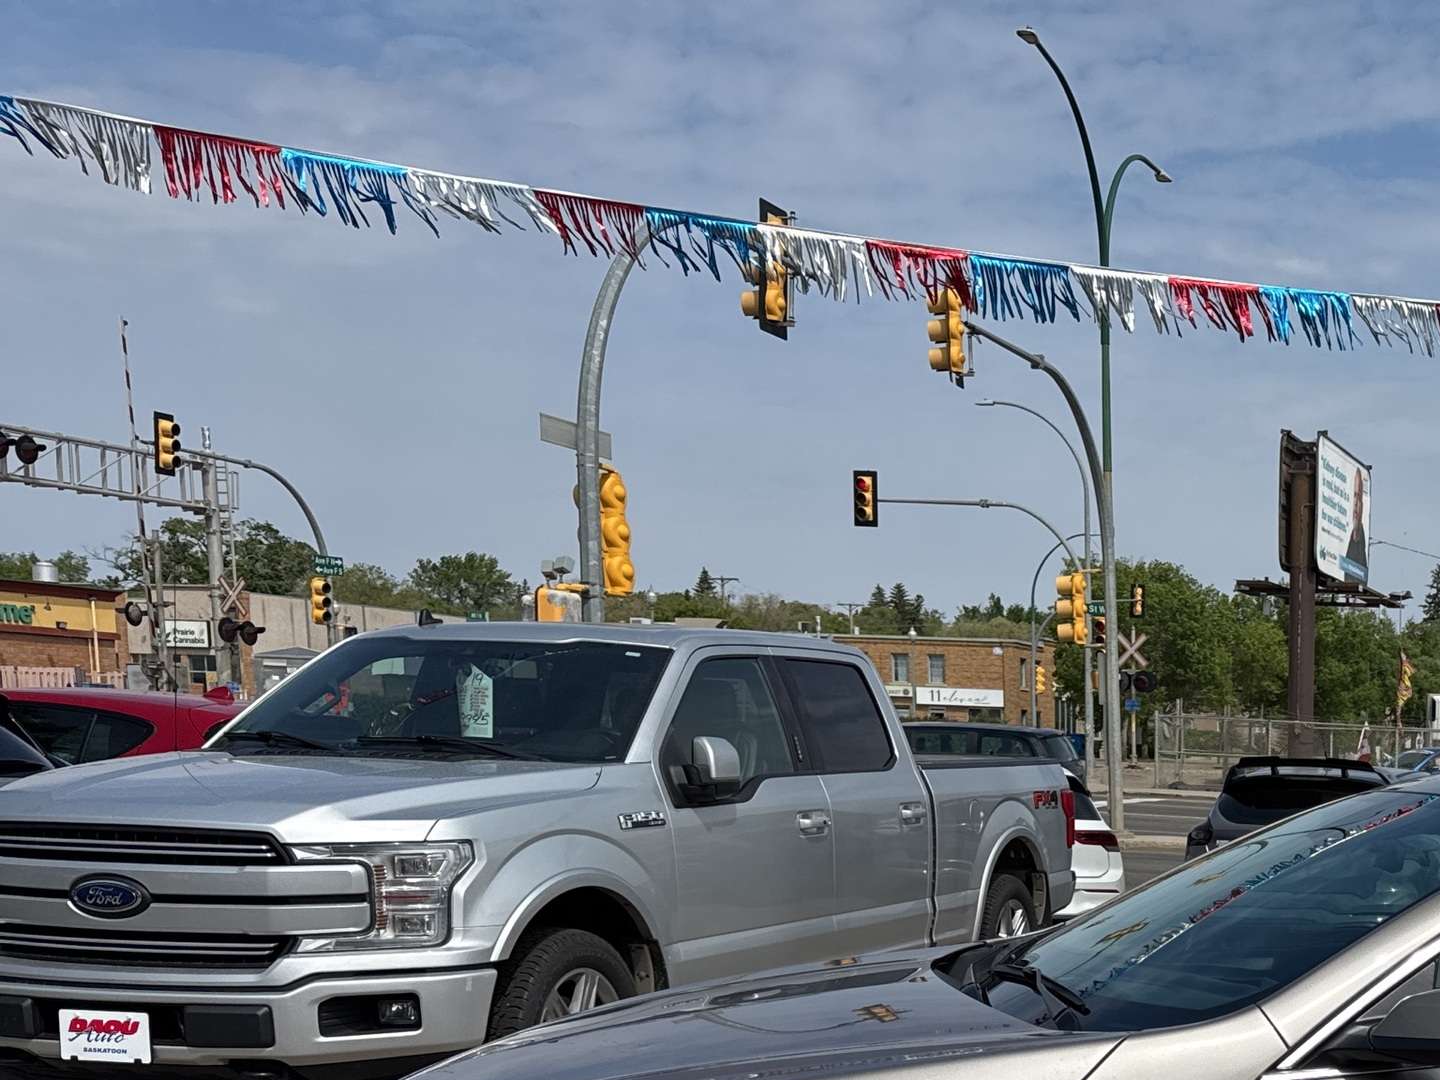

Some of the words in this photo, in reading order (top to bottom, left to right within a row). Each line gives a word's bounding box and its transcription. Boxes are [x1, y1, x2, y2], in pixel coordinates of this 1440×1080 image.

[929, 689, 941, 702] 11
[1033, 790, 1058, 809] FX4
[86, 886, 123, 904] Ford
[68, 1026, 125, 1043] Auto
[69, 1017, 140, 1036] DAOU
[83, 1047, 127, 1055] SASKATOON
